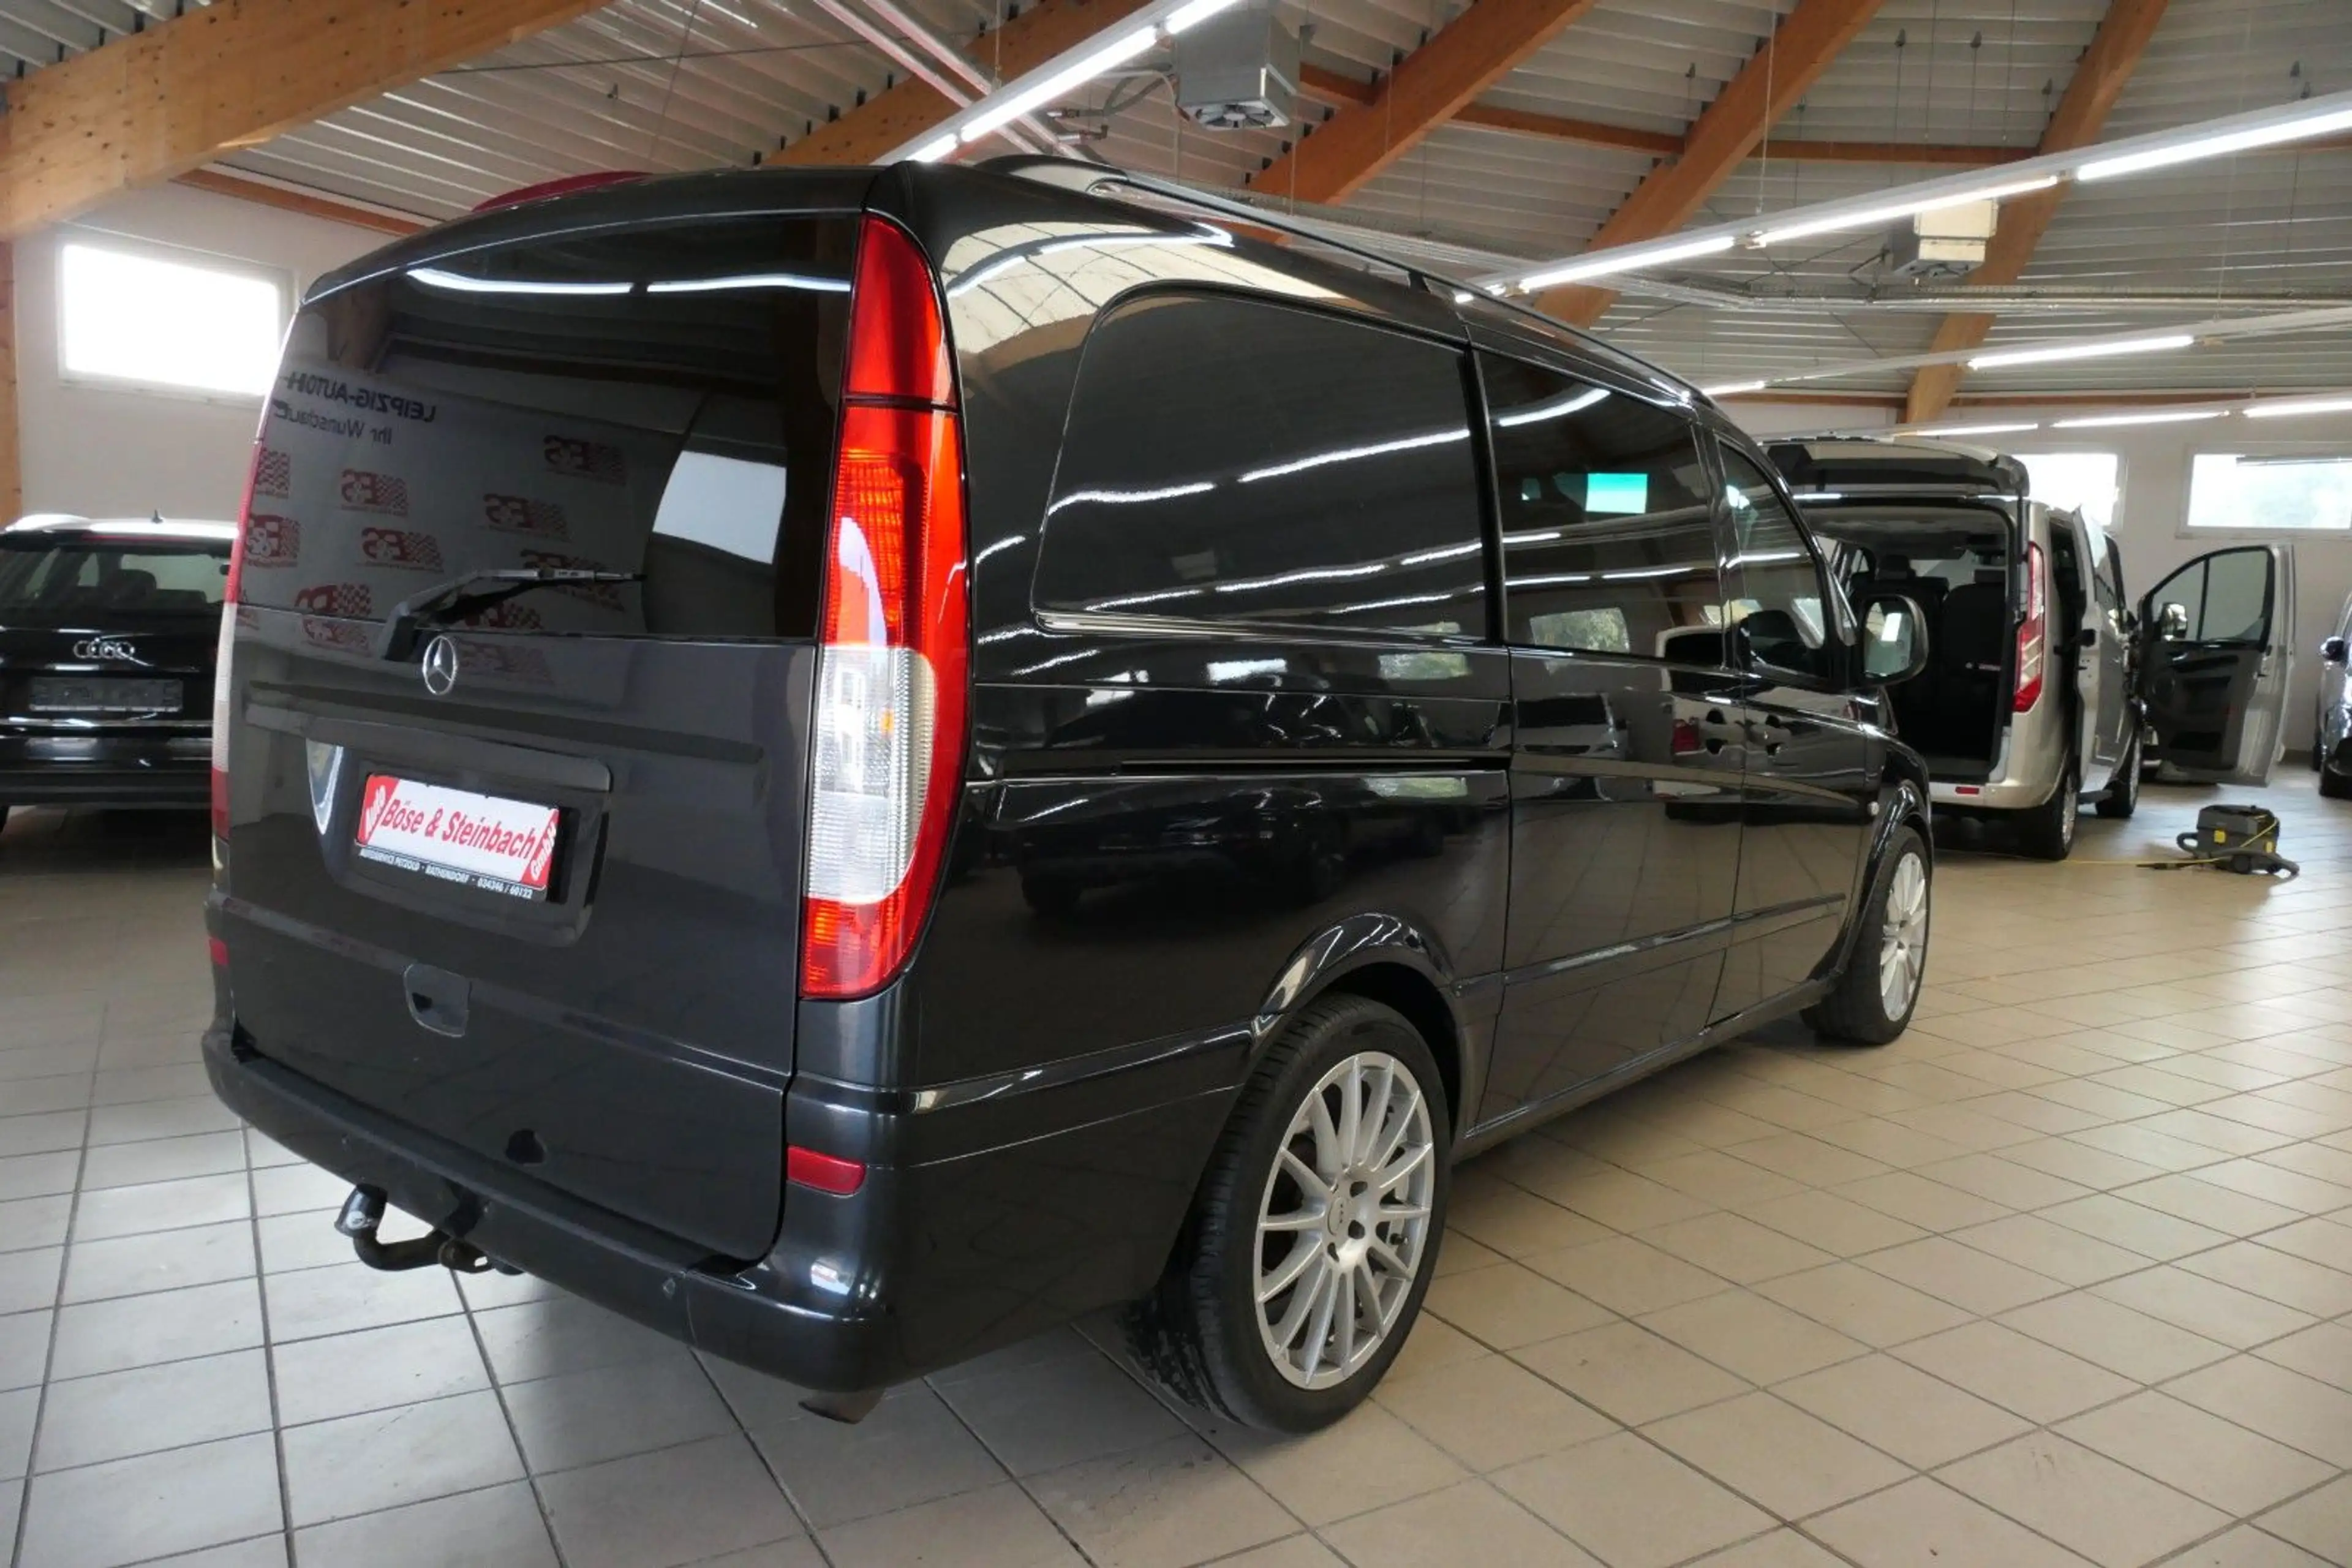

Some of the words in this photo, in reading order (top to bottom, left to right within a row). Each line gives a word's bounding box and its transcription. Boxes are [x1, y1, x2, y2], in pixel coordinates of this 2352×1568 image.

[381, 799, 424, 834] Böse
[425, 806, 443, 837] &
[442, 811, 535, 859] Steinbach
